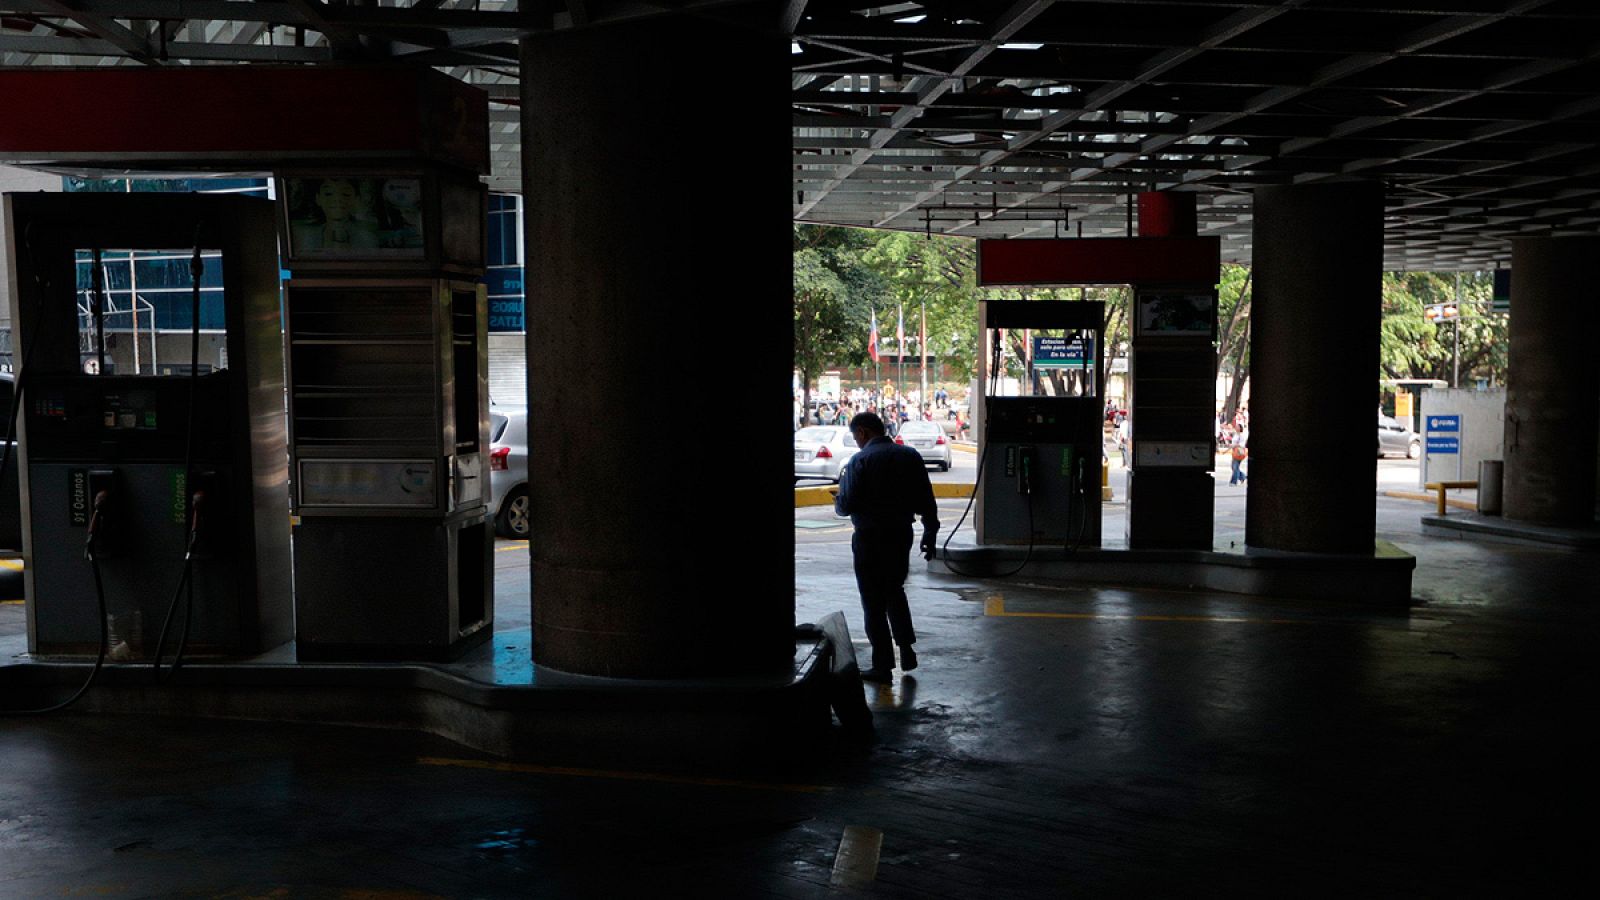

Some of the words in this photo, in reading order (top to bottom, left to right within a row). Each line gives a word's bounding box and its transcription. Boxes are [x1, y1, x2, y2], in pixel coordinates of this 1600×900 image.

[72, 472, 85, 510] Octanos
[174, 473, 186, 510] Octanos
[73, 511, 85, 523] 91
